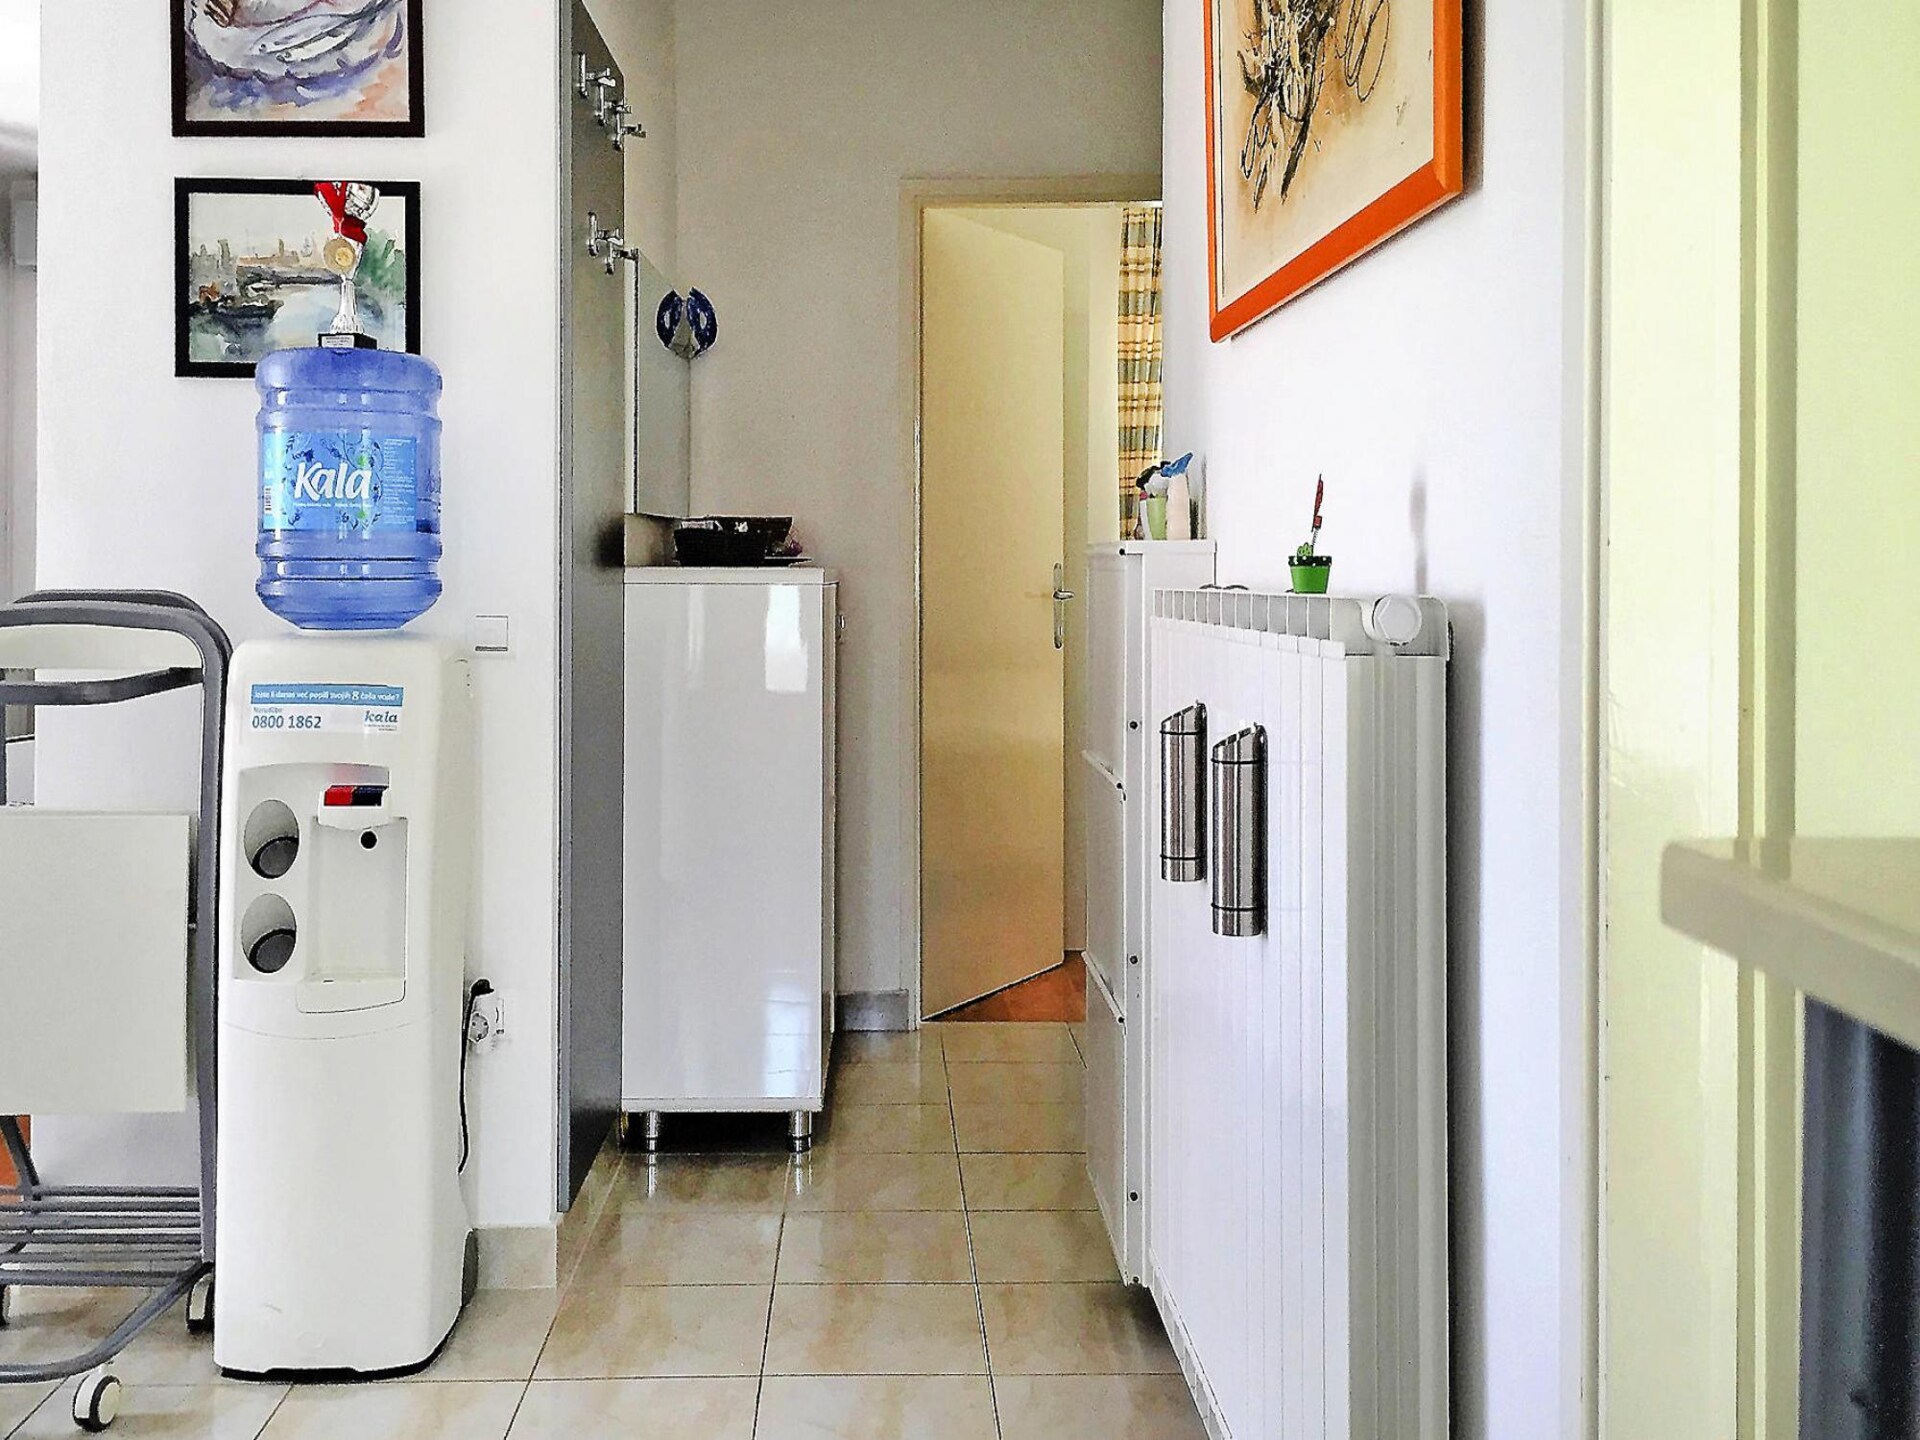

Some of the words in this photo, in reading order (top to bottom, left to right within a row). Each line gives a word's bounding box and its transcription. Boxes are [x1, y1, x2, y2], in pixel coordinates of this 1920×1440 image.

[293, 461, 372, 502] Kala
[352, 691, 360, 701] 8
[252, 714, 284, 729] 0800
[288, 714, 322, 729] 1862
